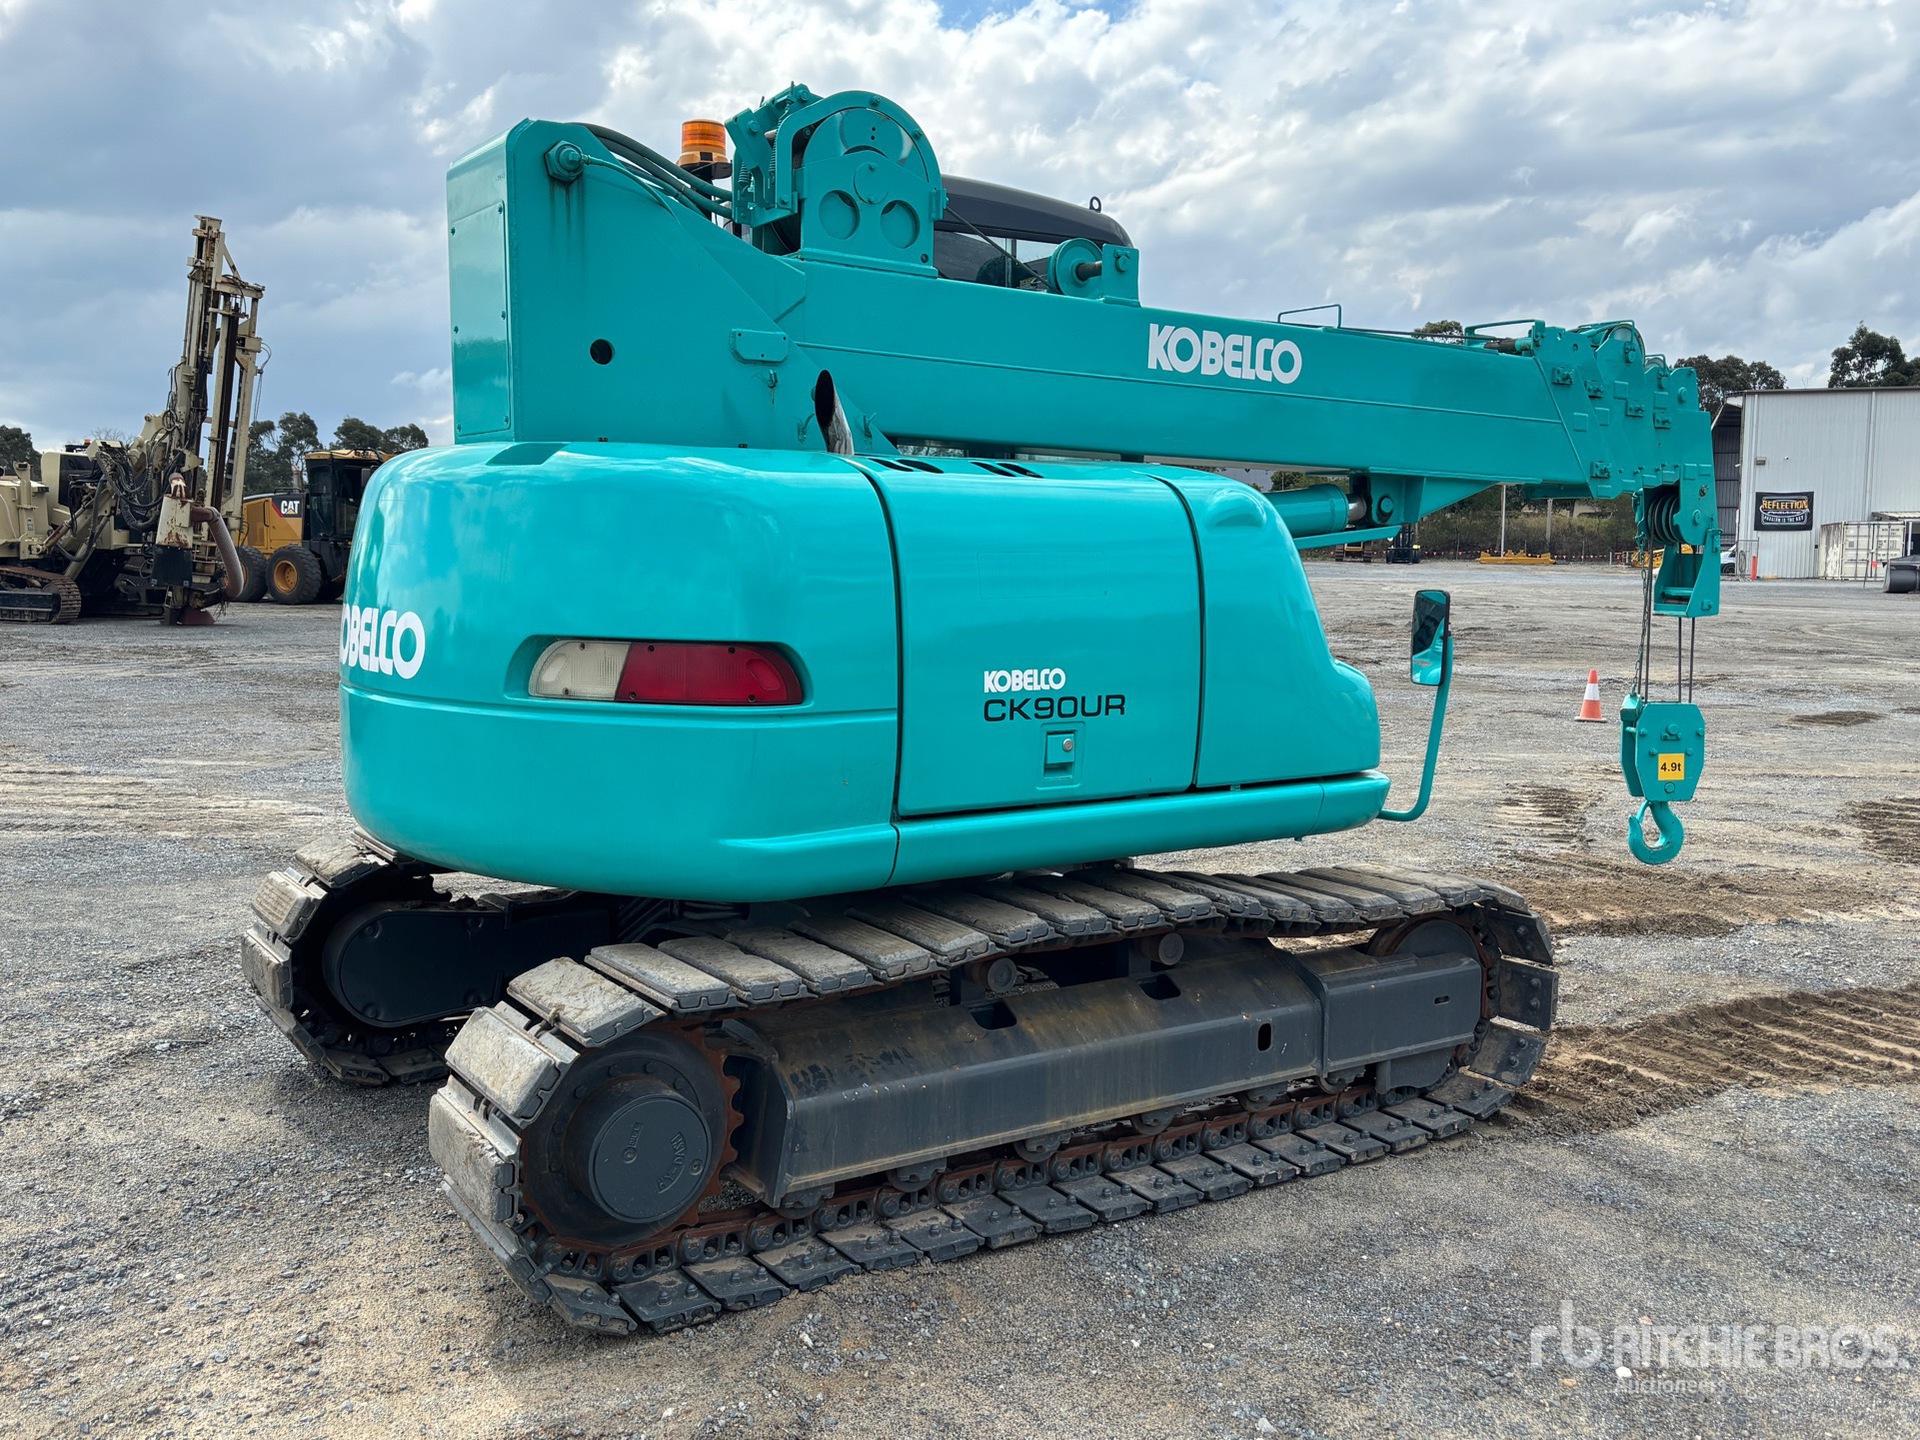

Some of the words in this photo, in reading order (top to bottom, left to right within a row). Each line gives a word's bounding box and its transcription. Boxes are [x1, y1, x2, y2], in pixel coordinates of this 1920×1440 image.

[1148, 323, 1302, 384] KOBELCO
[281, 500, 300, 515] CAT
[1762, 500, 1808, 510] REFLECTION
[340, 603, 426, 680] OBELCO
[984, 668, 1066, 693] KOBELCO
[984, 694, 1126, 722] CK90UR
[1660, 762, 1682, 772] 4.9t
